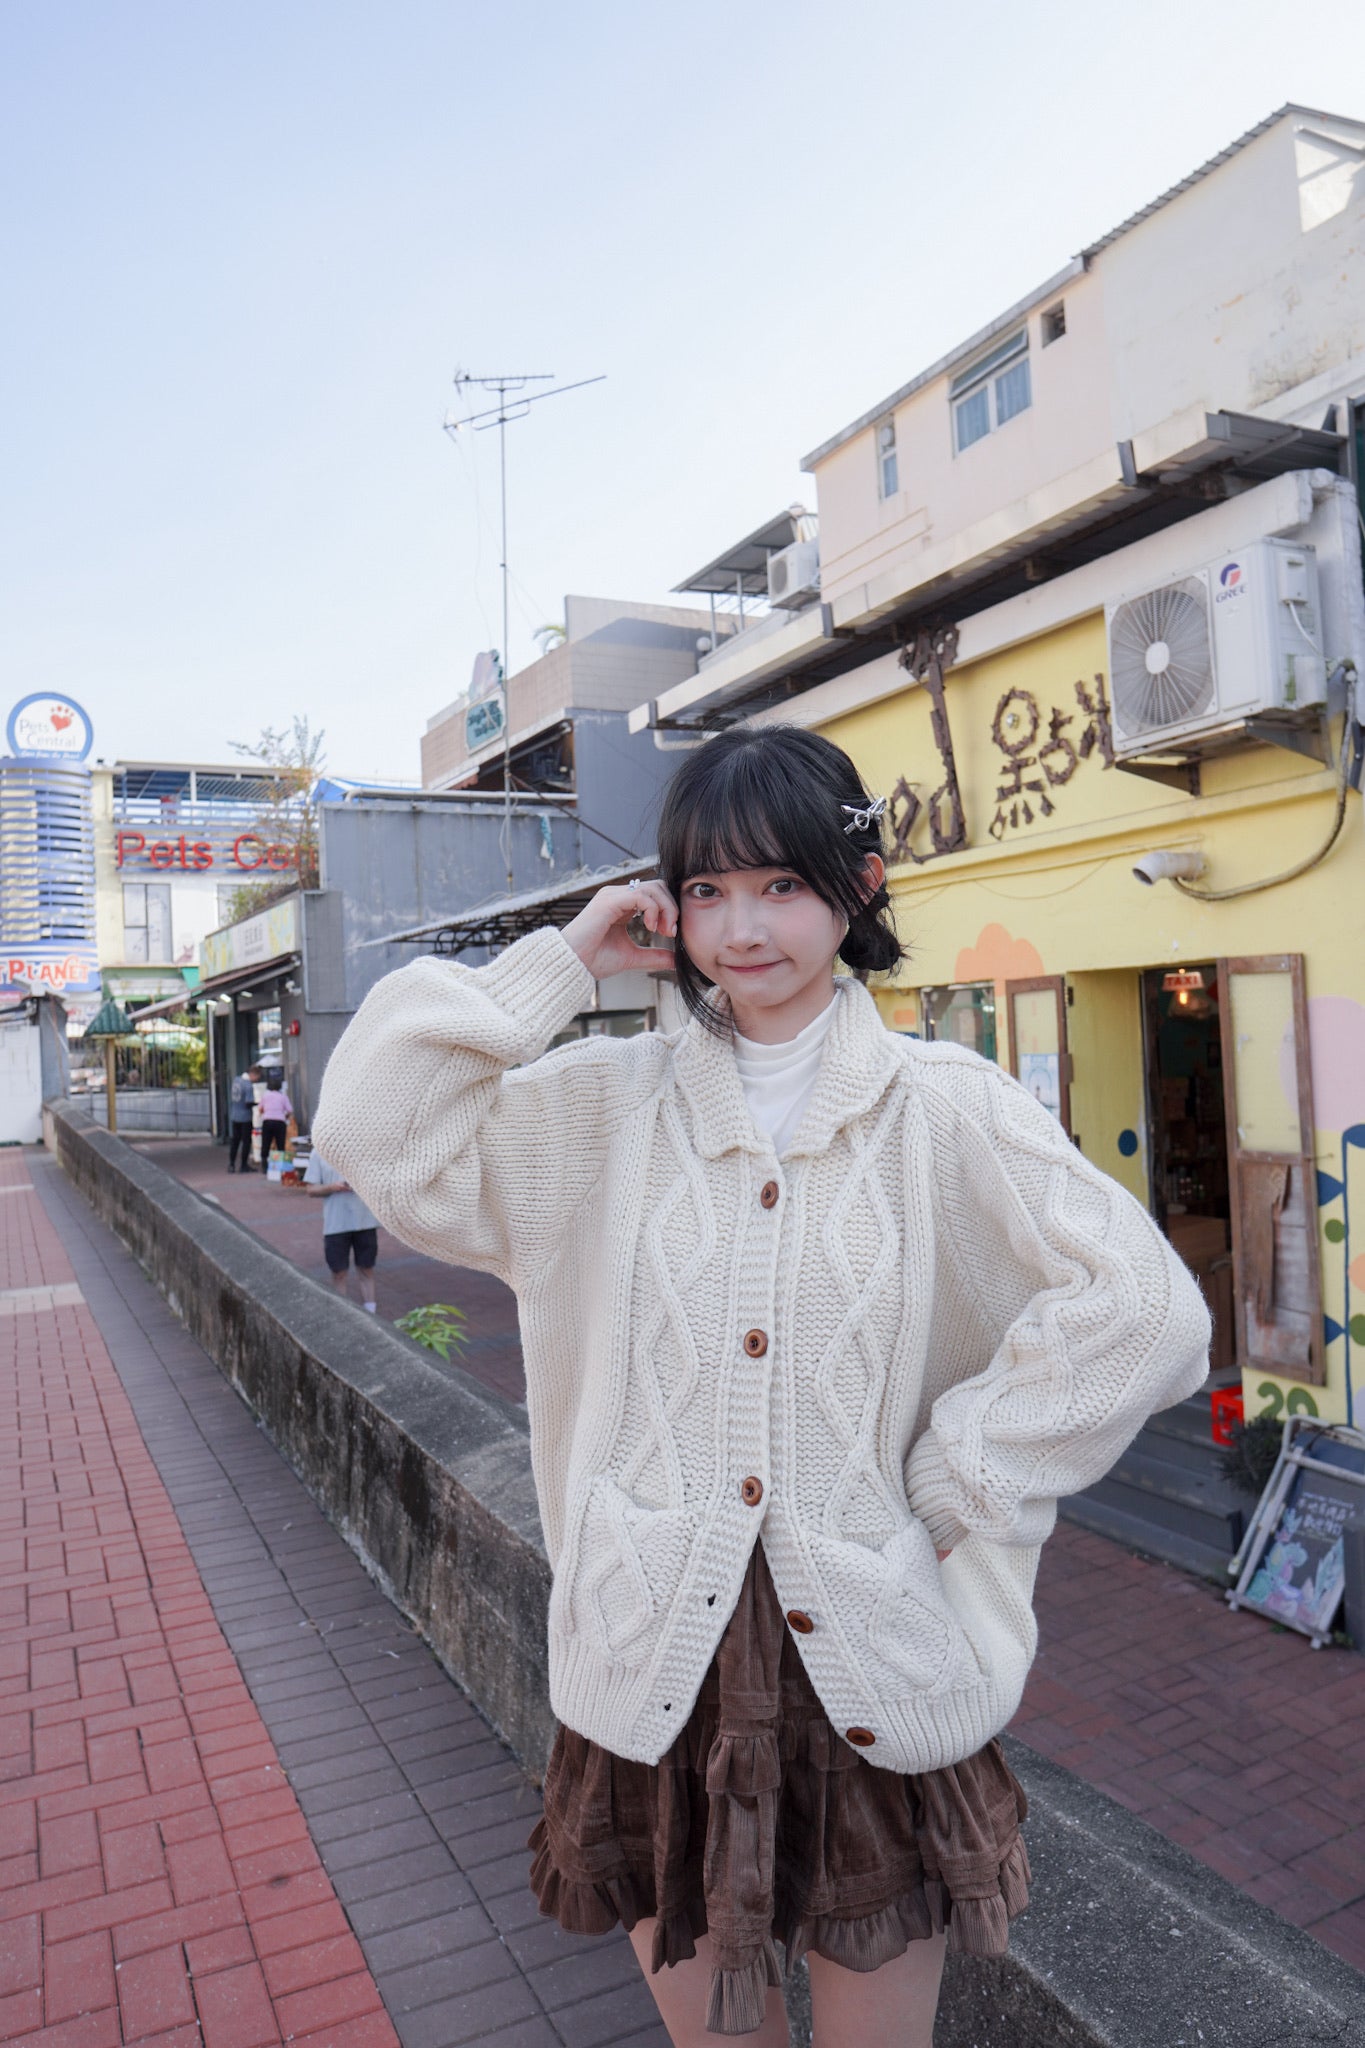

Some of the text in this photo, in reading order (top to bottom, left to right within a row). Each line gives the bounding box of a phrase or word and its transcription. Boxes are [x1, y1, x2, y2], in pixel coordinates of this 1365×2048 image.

[19, 719, 49, 733] Pets
[26, 733, 76, 747] Central
[115, 831, 214, 870] Pets
[8, 955, 88, 988] PLANET
[1165, 975, 1198, 986] TAXI
